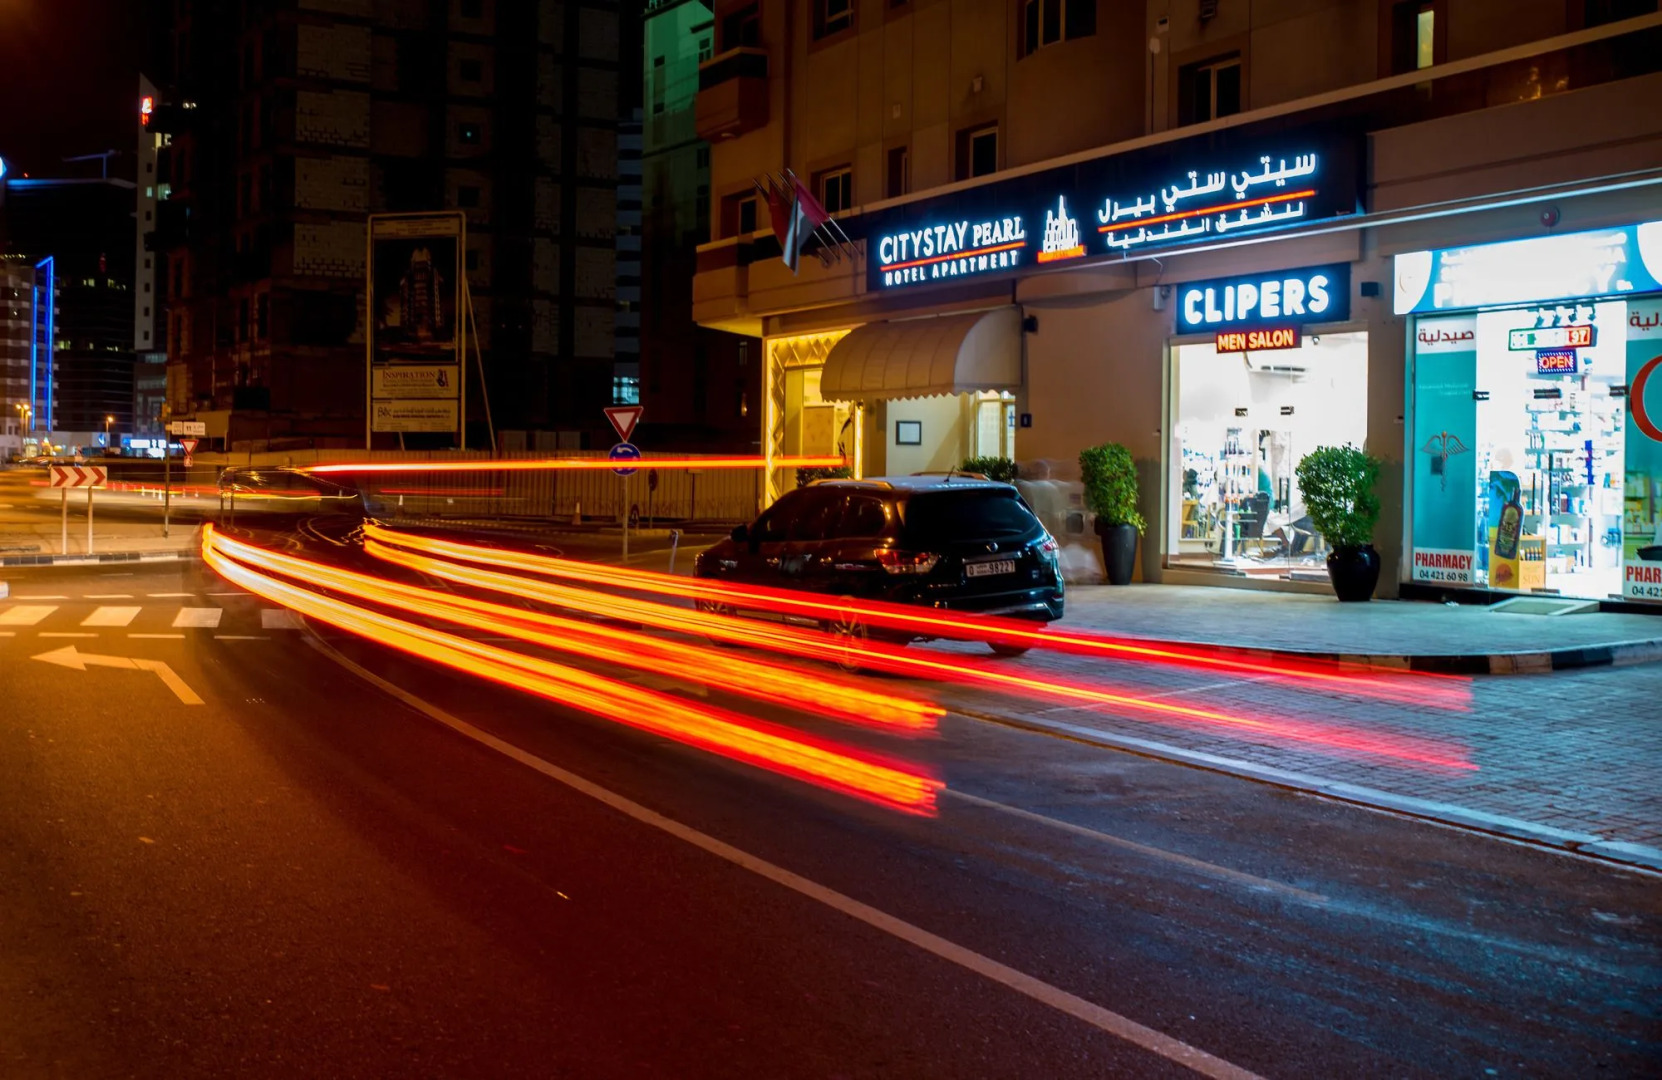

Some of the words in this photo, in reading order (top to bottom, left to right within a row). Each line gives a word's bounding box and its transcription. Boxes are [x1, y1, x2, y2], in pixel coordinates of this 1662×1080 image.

[1231, 153, 1316, 199] سيتي
[1161, 170, 1226, 212] ستي
[1098, 194, 1156, 223] بيرل
[1215, 201, 1304, 233] للشقق
[879, 220, 968, 264] CITYSTAY
[972, 216, 1025, 247] PEARL
[1106, 217, 1210, 248] الفندقية
[885, 266, 926, 286] HOTEL
[932, 250, 1018, 279] APARTMENT
[1184, 274, 1329, 325] CLIPERS
[1217, 333, 1246, 351] MEN
[1248, 329, 1294, 349] SALON
[1418, 328, 1475, 346] صيدلية
[382, 368, 436, 379] INSPIRATION
[1541, 355, 1572, 369] OPEN
[1415, 552, 1472, 571] PHARMACY
[1419, 570, 1429, 579] 04
[1430, 571, 1445, 580] 421
[1447, 572, 1457, 581] 60
[1458, 573, 1468, 581] 98
[1631, 585, 1644, 596] 04
